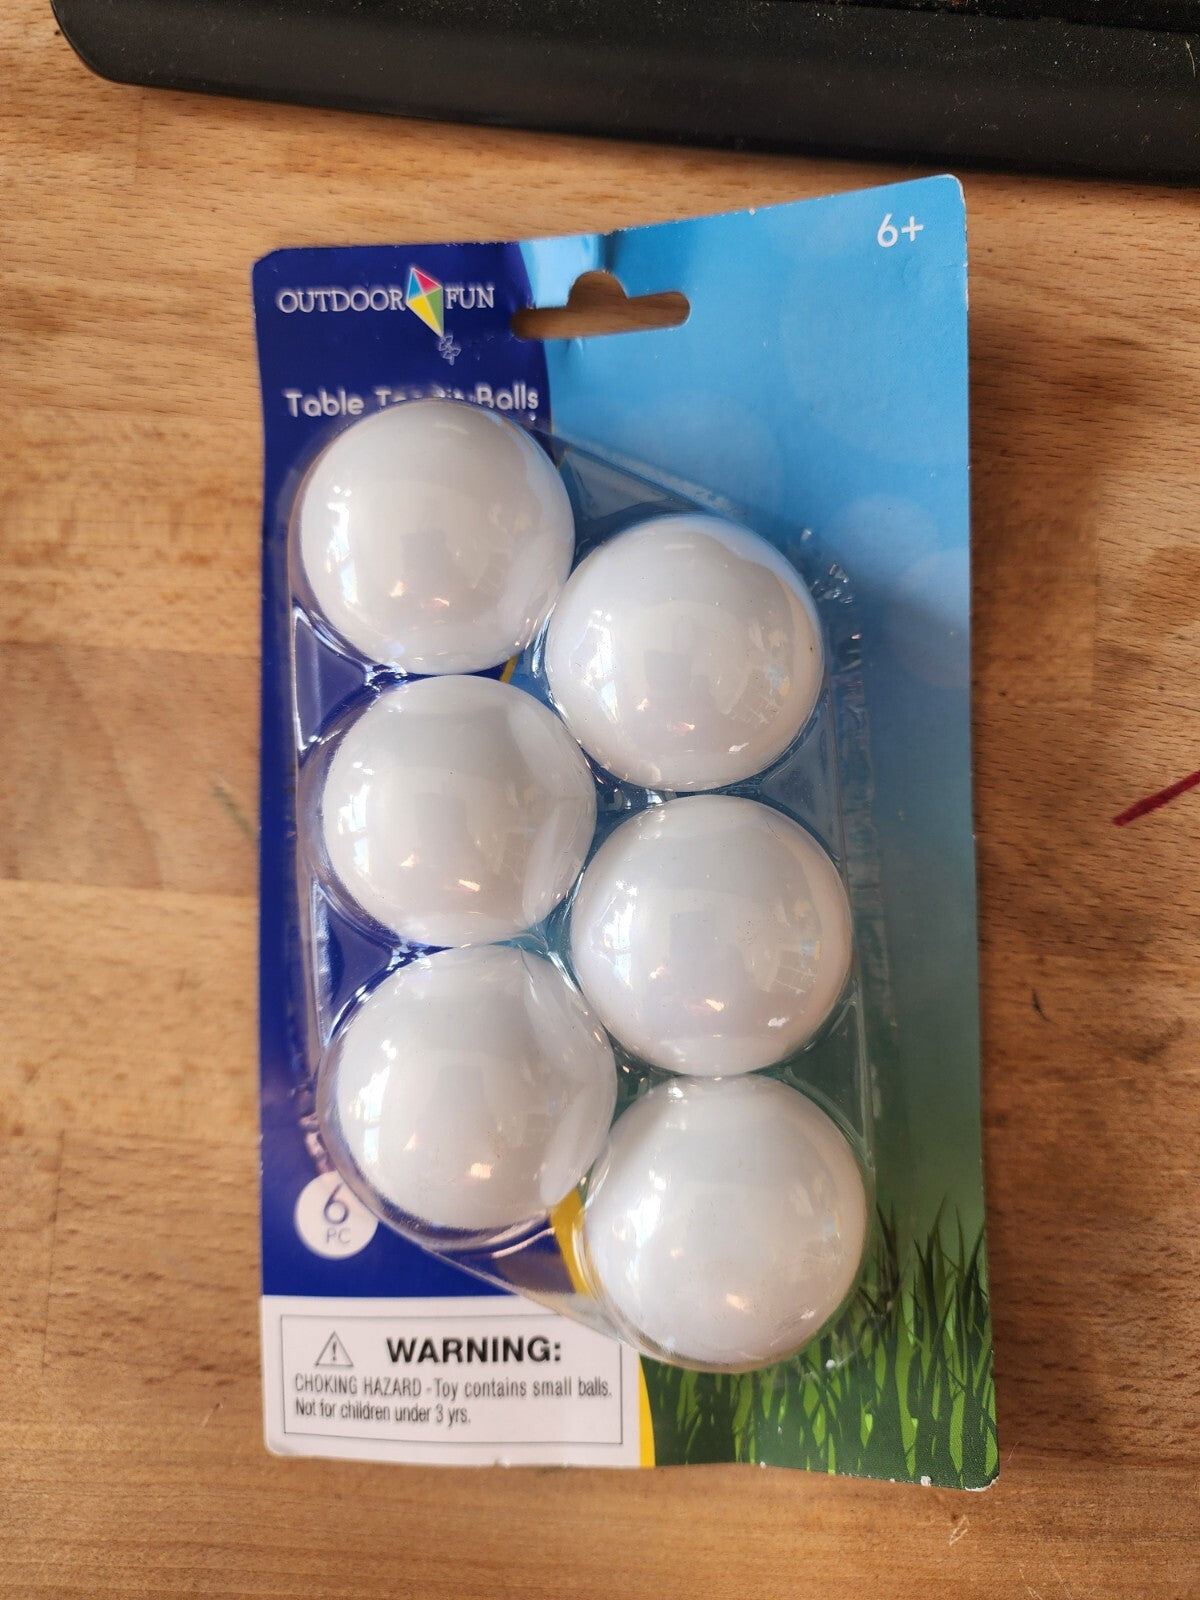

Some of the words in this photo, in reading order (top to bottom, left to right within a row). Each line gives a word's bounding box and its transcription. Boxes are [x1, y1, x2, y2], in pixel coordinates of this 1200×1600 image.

[877, 213, 924, 248] 6+
[278, 289, 406, 313] OUTDOOR
[445, 287, 494, 309] FUN
[286, 387, 364, 417] Table
[323, 1182, 350, 1225] 6
[326, 1227, 351, 1245] PC
[386, 1336, 561, 1363] WARNING:
[295, 1373, 358, 1394] CHOKING
[363, 1376, 422, 1397] HAZARD
[464, 1377, 527, 1398] contains
[533, 1375, 572, 1397] small
[578, 1375, 613, 1397] balls.
[295, 1399, 317, 1416] Not
[320, 1398, 336, 1417] for
[340, 1400, 391, 1421] children
[395, 1403, 432, 1422] under
[435, 1404, 444, 1422] 3
[448, 1406, 471, 1427] yrs.
